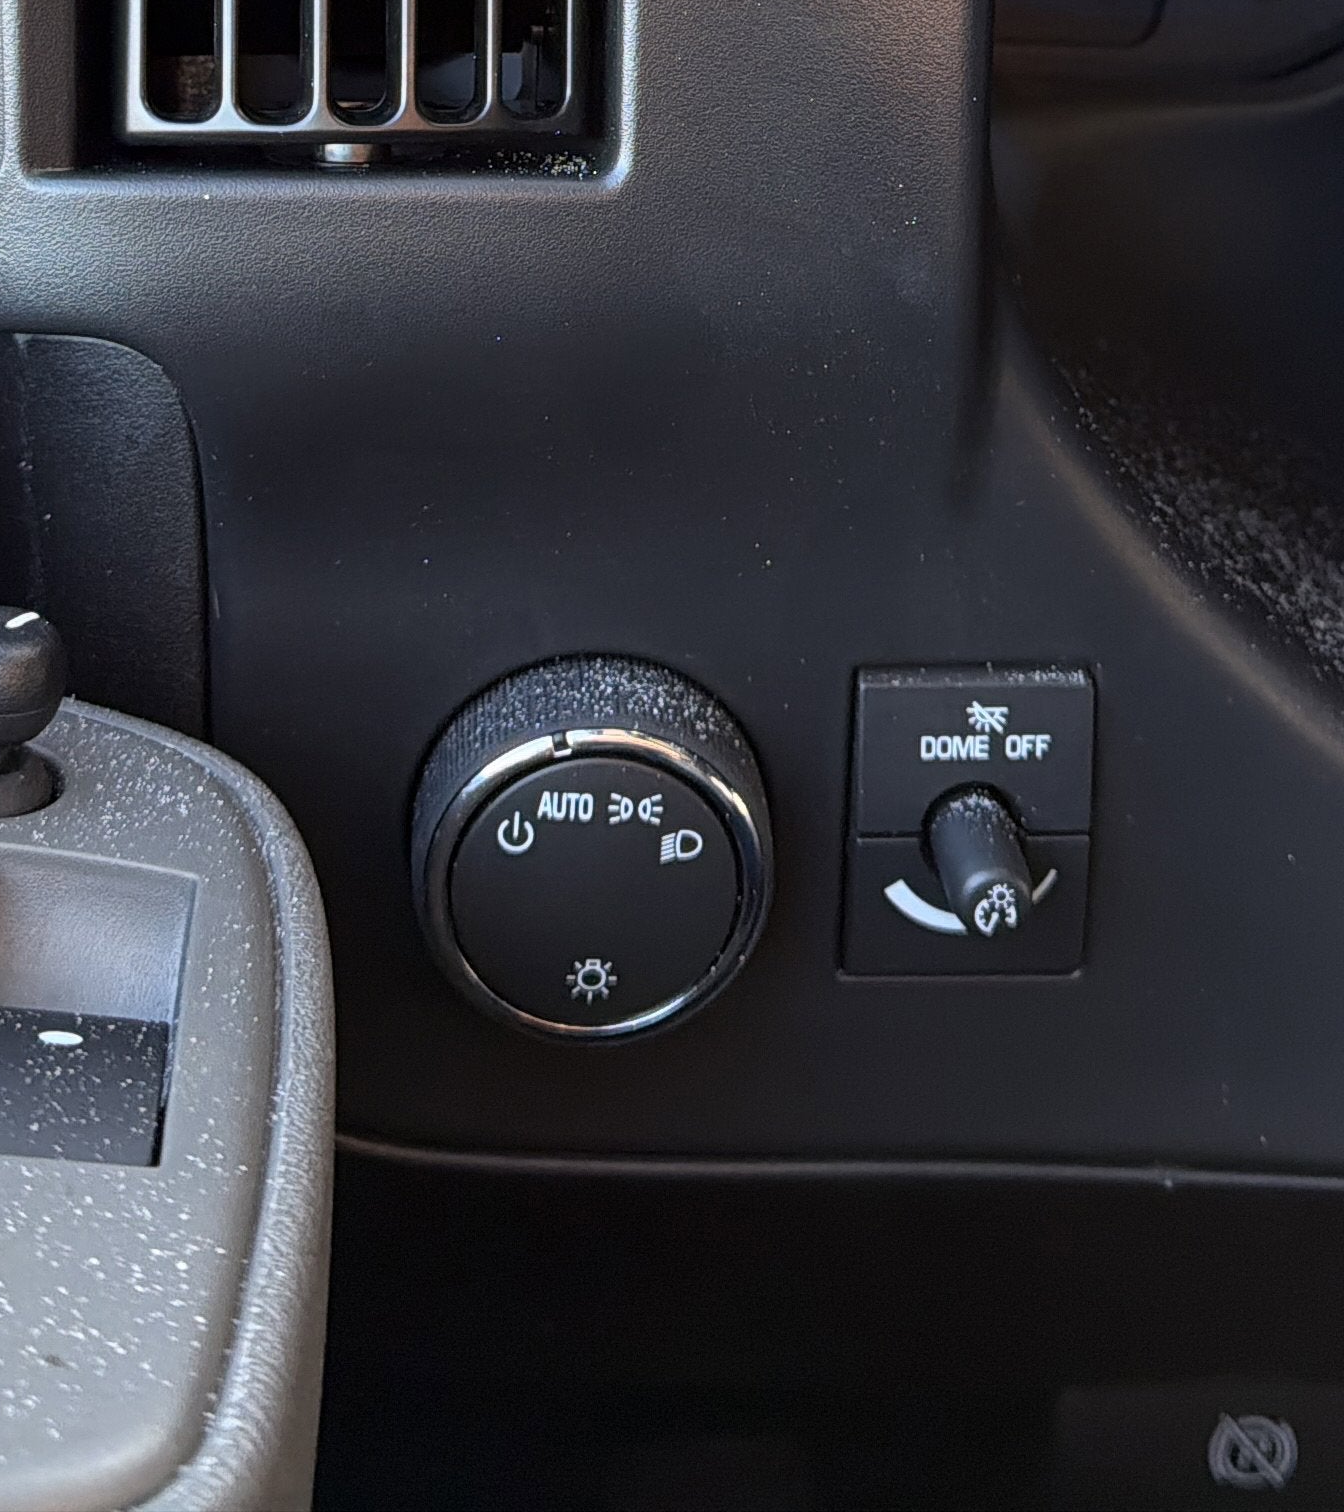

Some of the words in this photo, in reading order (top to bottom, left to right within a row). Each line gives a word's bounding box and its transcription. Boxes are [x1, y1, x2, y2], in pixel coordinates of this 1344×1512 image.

[920, 734, 990, 761] DOME
[1005, 734, 1052, 761] OFF
[536, 790, 594, 823] AUTO
